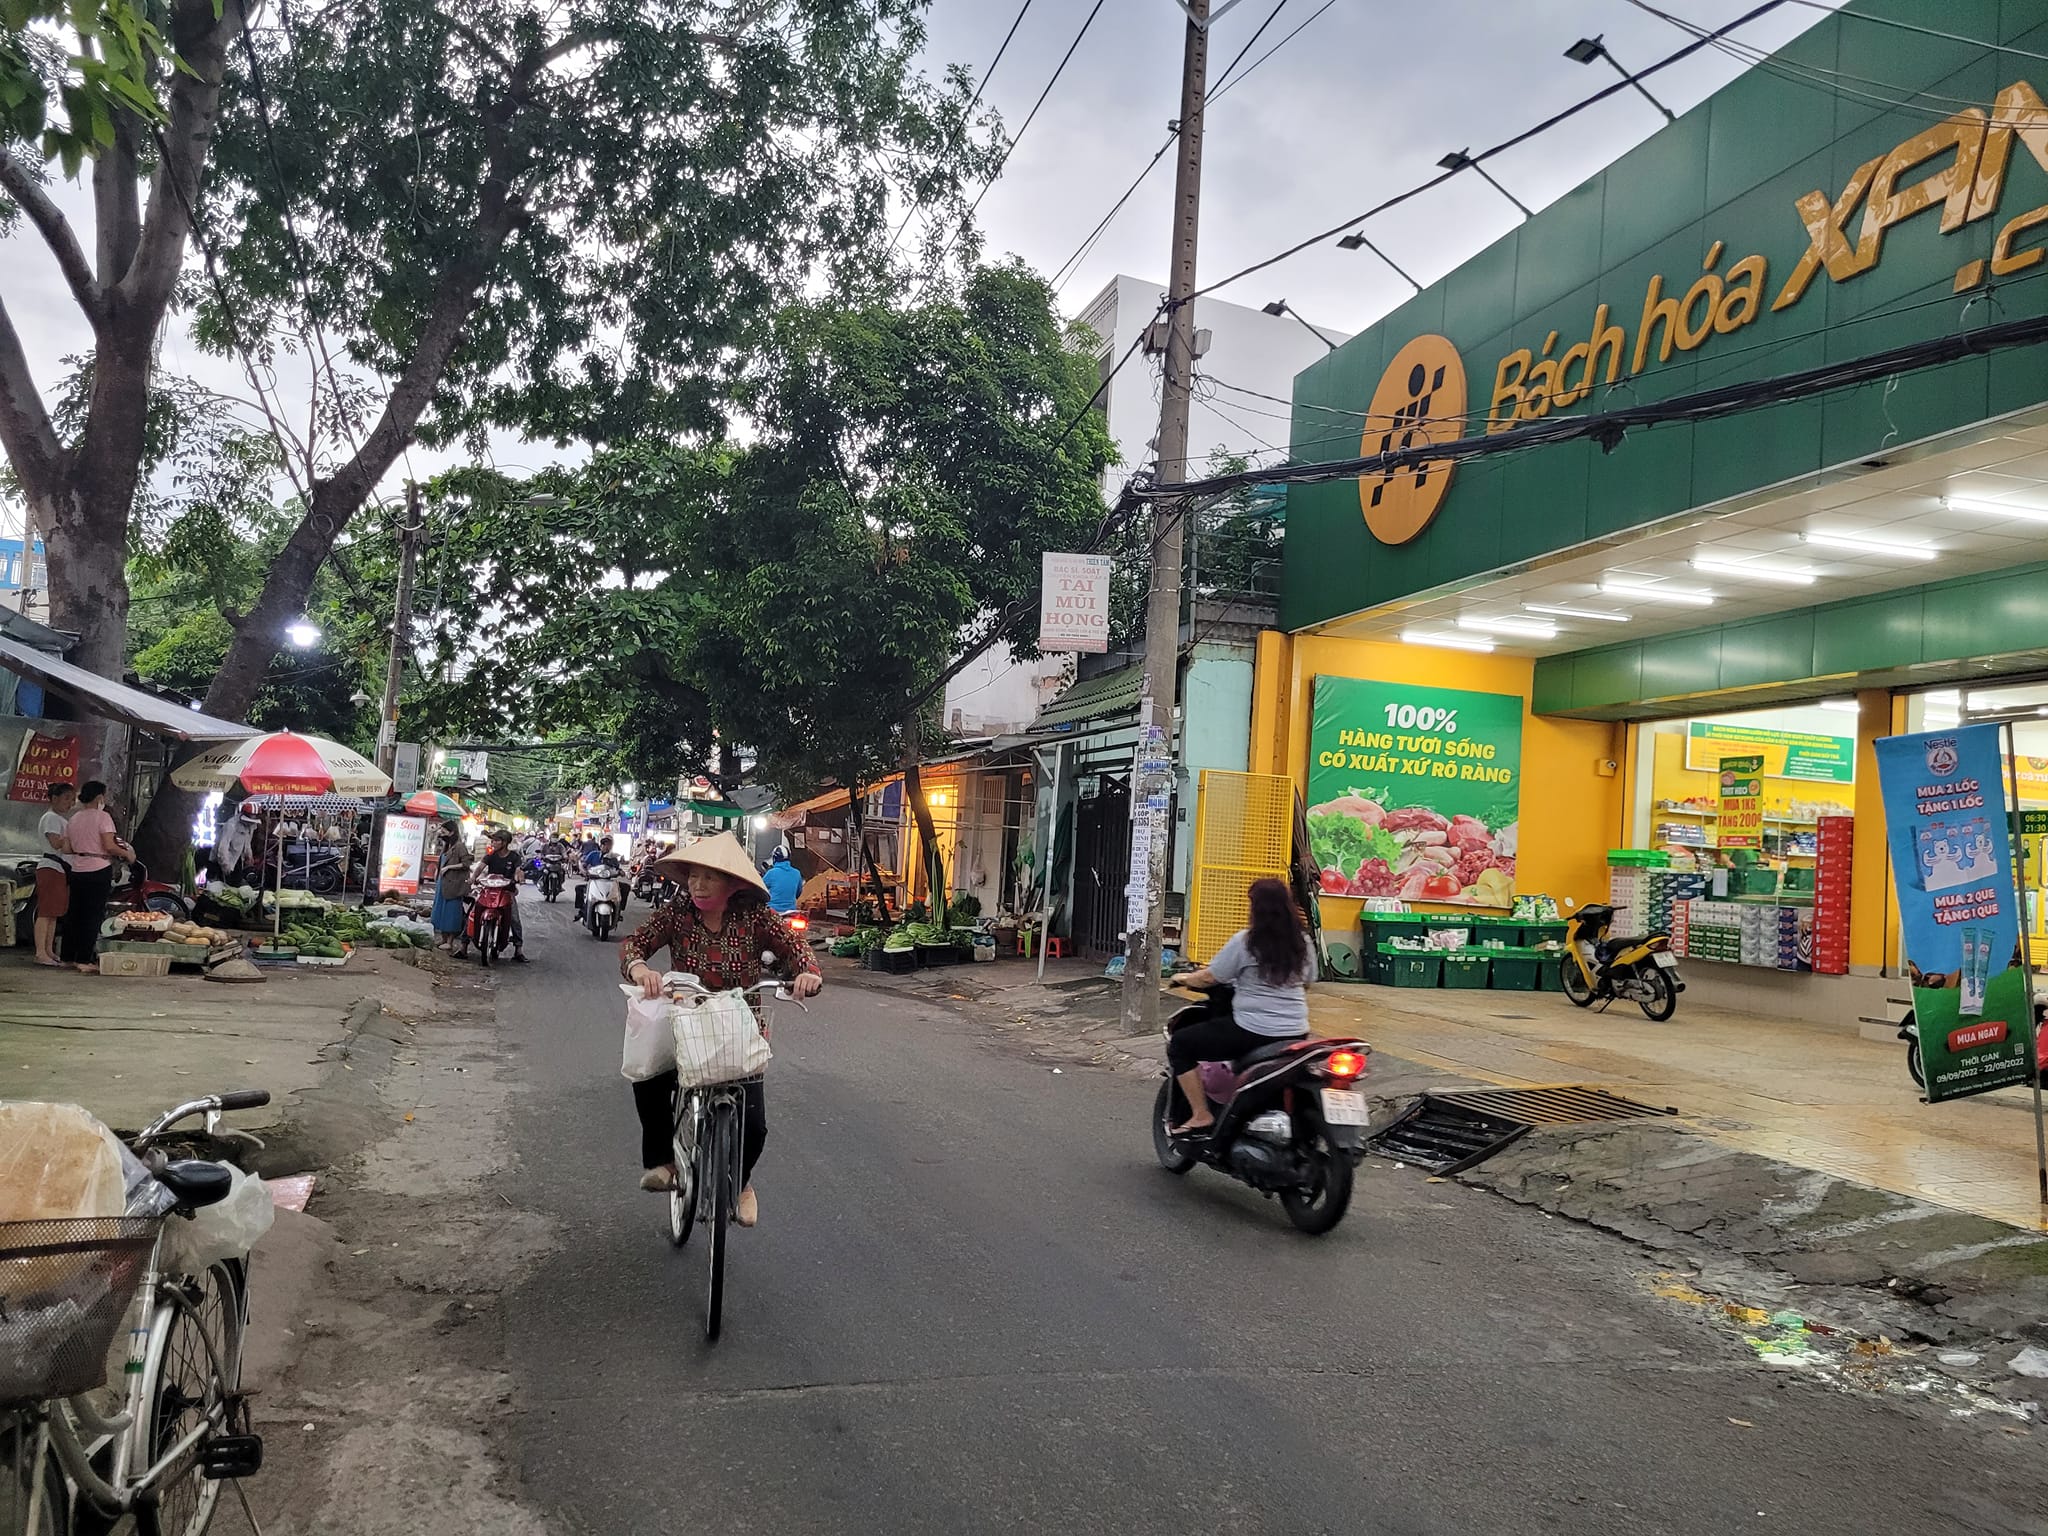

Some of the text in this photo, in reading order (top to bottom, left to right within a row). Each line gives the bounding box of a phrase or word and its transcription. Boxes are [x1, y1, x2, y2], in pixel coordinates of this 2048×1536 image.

[1487, 329, 1625, 436] Bách
[1631, 239, 1768, 375] hóa
[1059, 578, 1094, 592] TAI
[1044, 612, 1105, 628] HỌNG
[1384, 703, 1458, 734] 100%
[1339, 727, 1496, 760] HÀNG TƯƠI SỐNG
[1319, 750, 1512, 784] CÓ XUẤT XỨ RÕ RÀNG
[1917, 777, 1979, 798] MUA 2 LỐC
[1917, 794, 1984, 816] TẶNG 1 LỐC
[2025, 824, 2046, 833] 21:30
[1935, 888, 1996, 908] MUA 2 QUE
[1934, 909, 1970, 925] TẶNG
[1977, 903, 1999, 918] QUE
[1956, 1026, 1999, 1045] MUA NGAY
[1980, 1051, 2000, 1063] GIAN
[1936, 1067, 1978, 1083] 09/09/2022
[1984, 1057, 2024, 1073] 22/09/2022
